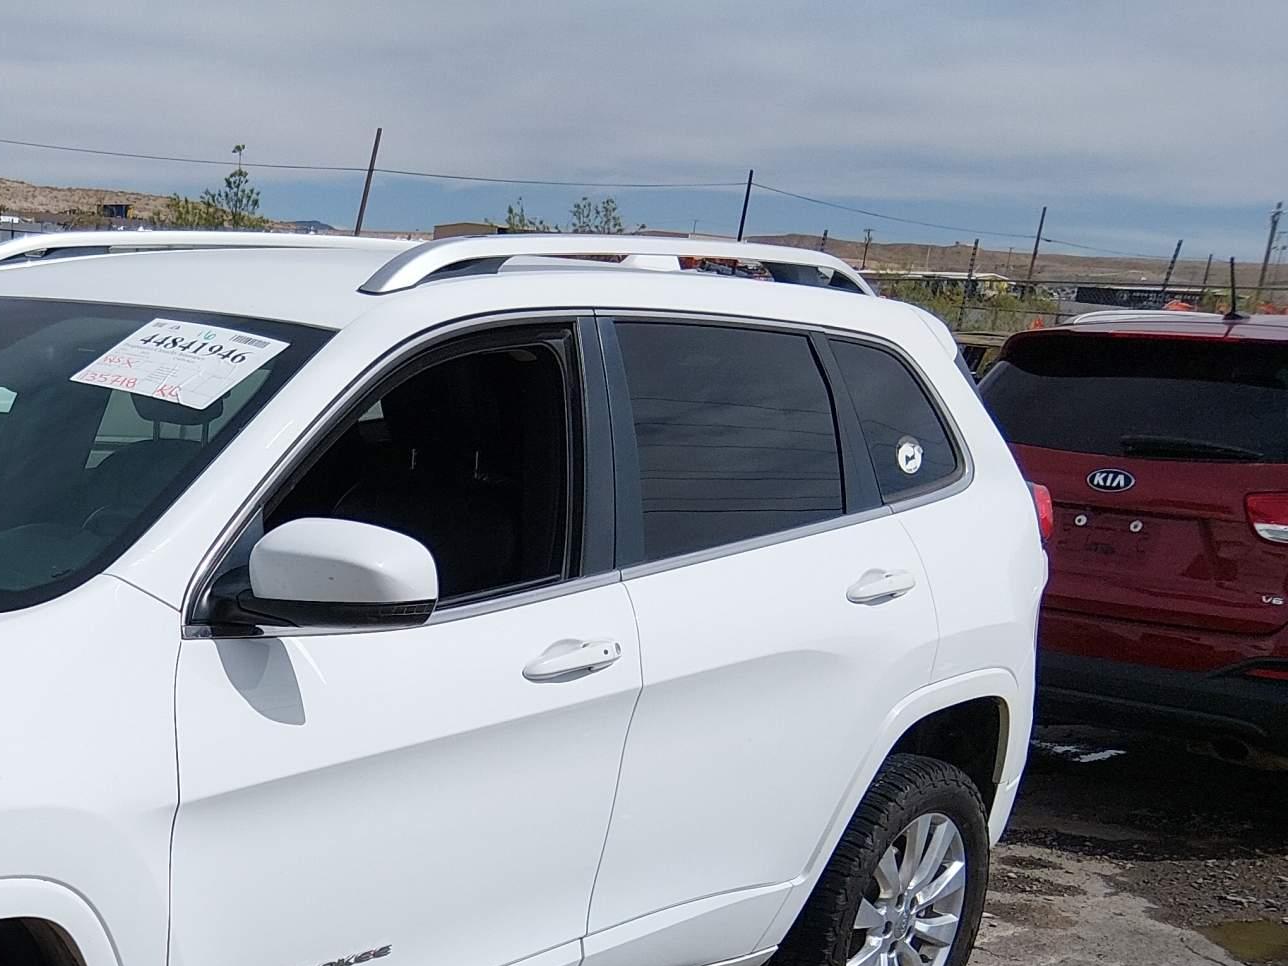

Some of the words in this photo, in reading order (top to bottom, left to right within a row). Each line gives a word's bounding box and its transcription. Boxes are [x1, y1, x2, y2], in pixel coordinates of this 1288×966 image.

[140, 333, 252, 364] 44841946
[1093, 472, 1125, 488] KIA
[1261, 595, 1284, 605] V6
